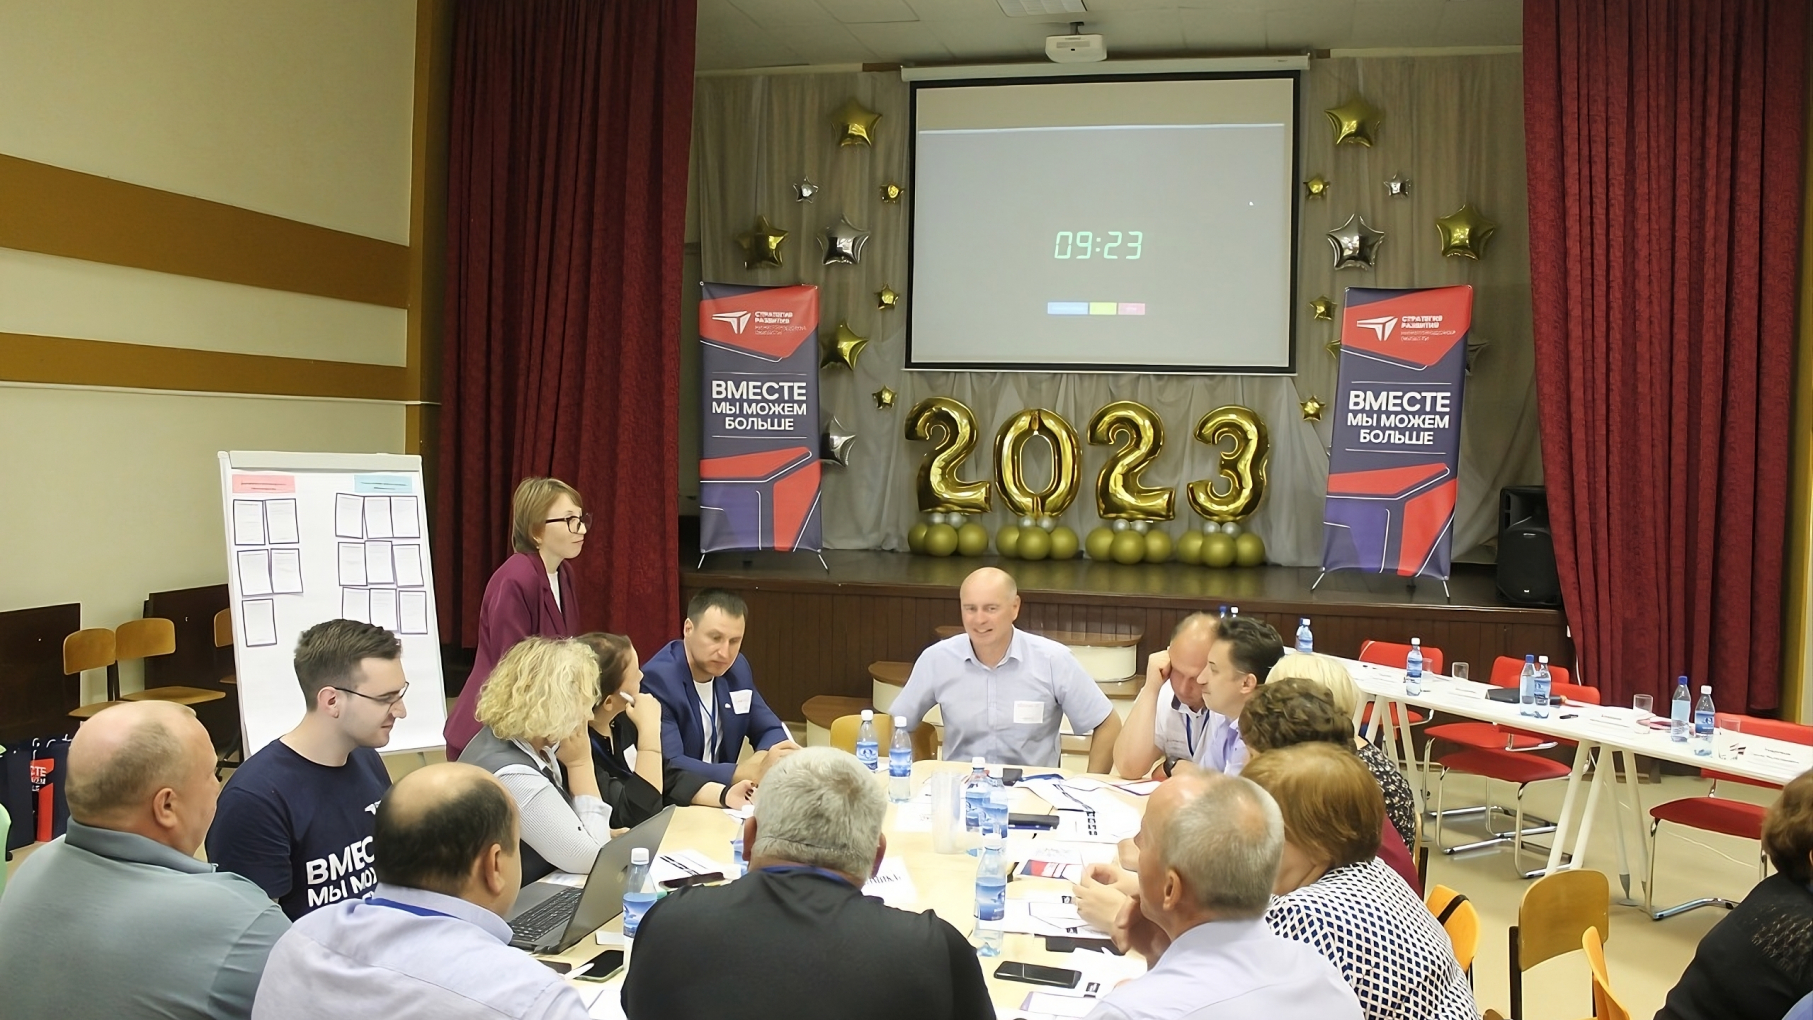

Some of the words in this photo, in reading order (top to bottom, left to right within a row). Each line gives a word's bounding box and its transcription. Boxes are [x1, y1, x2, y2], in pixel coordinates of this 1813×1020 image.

[1054, 231, 1143, 259] 09:23
[712, 380, 807, 400] ВМЕСТЕ
[712, 401, 739, 414] МЫ
[743, 402, 807, 415] МОЖЕМ
[1348, 390, 1451, 412] ВМЕСТЕ
[725, 417, 794, 430] БОЛЬШЕ
[1347, 412, 1377, 427] МЫ
[1380, 414, 1450, 429] МОЖЕМ
[1360, 429, 1434, 445] БОЛЬШЕ
[905, 397, 1271, 522] 2023
[307, 879, 348, 908] МЫ
